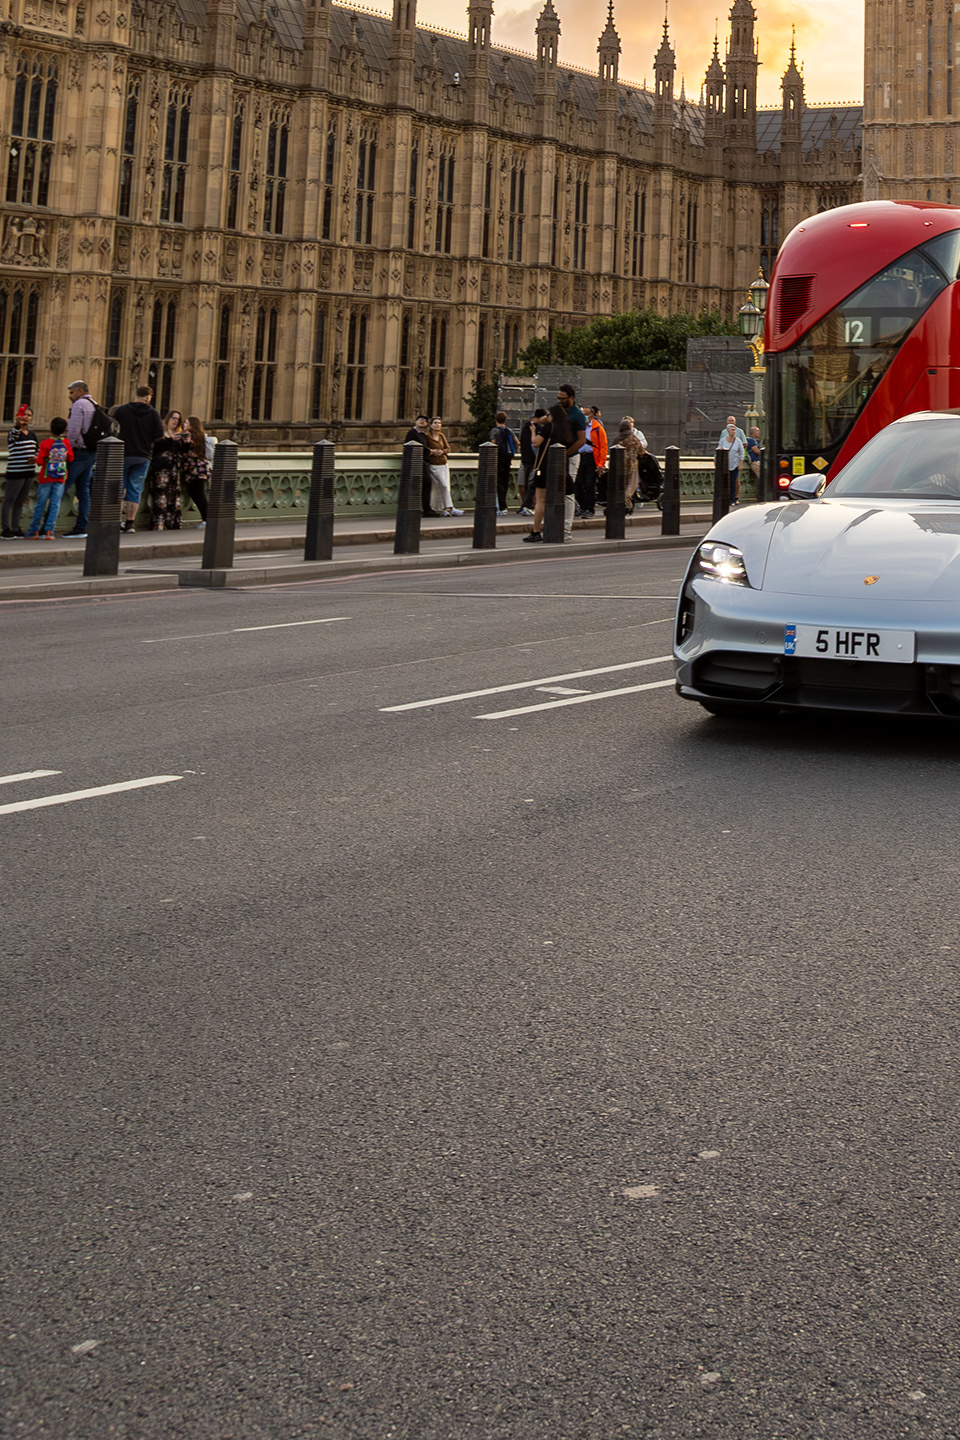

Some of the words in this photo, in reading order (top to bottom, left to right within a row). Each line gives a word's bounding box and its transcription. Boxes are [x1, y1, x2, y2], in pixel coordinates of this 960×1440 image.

[845, 320, 864, 343] 12
[815, 630, 829, 653] 5
[835, 631, 881, 657] HFR
